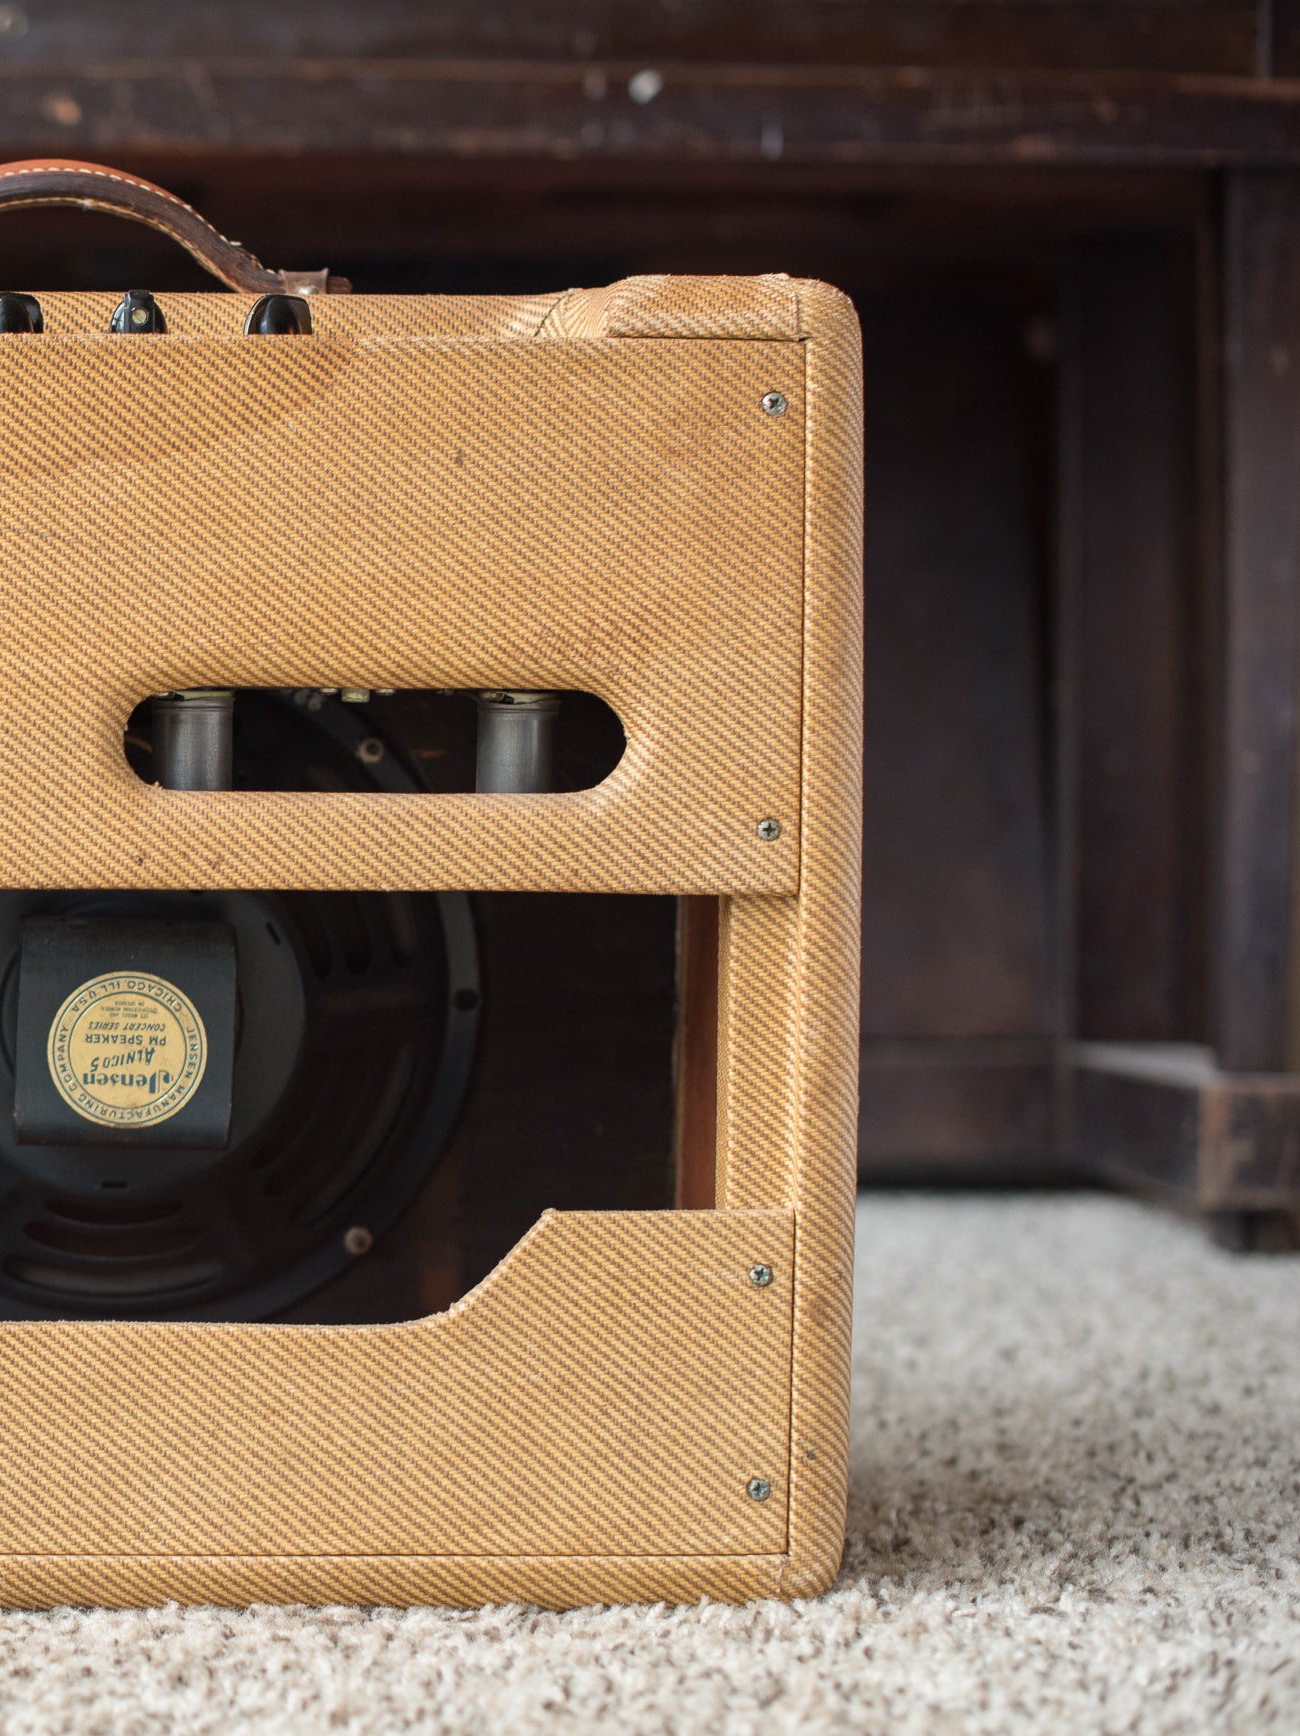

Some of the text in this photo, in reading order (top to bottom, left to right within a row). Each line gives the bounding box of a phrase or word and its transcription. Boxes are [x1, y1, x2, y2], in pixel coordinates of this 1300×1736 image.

[88, 1021, 166, 1031] CONCERT SERIES
[84, 1034, 166, 1045] PM SPEAKER
[90, 1047, 155, 1072] ALNICO 5
[57, 1025, 198, 1120] JENSEN MANUFACTURING COMPANY
[83, 1070, 173, 1094] Jensen
